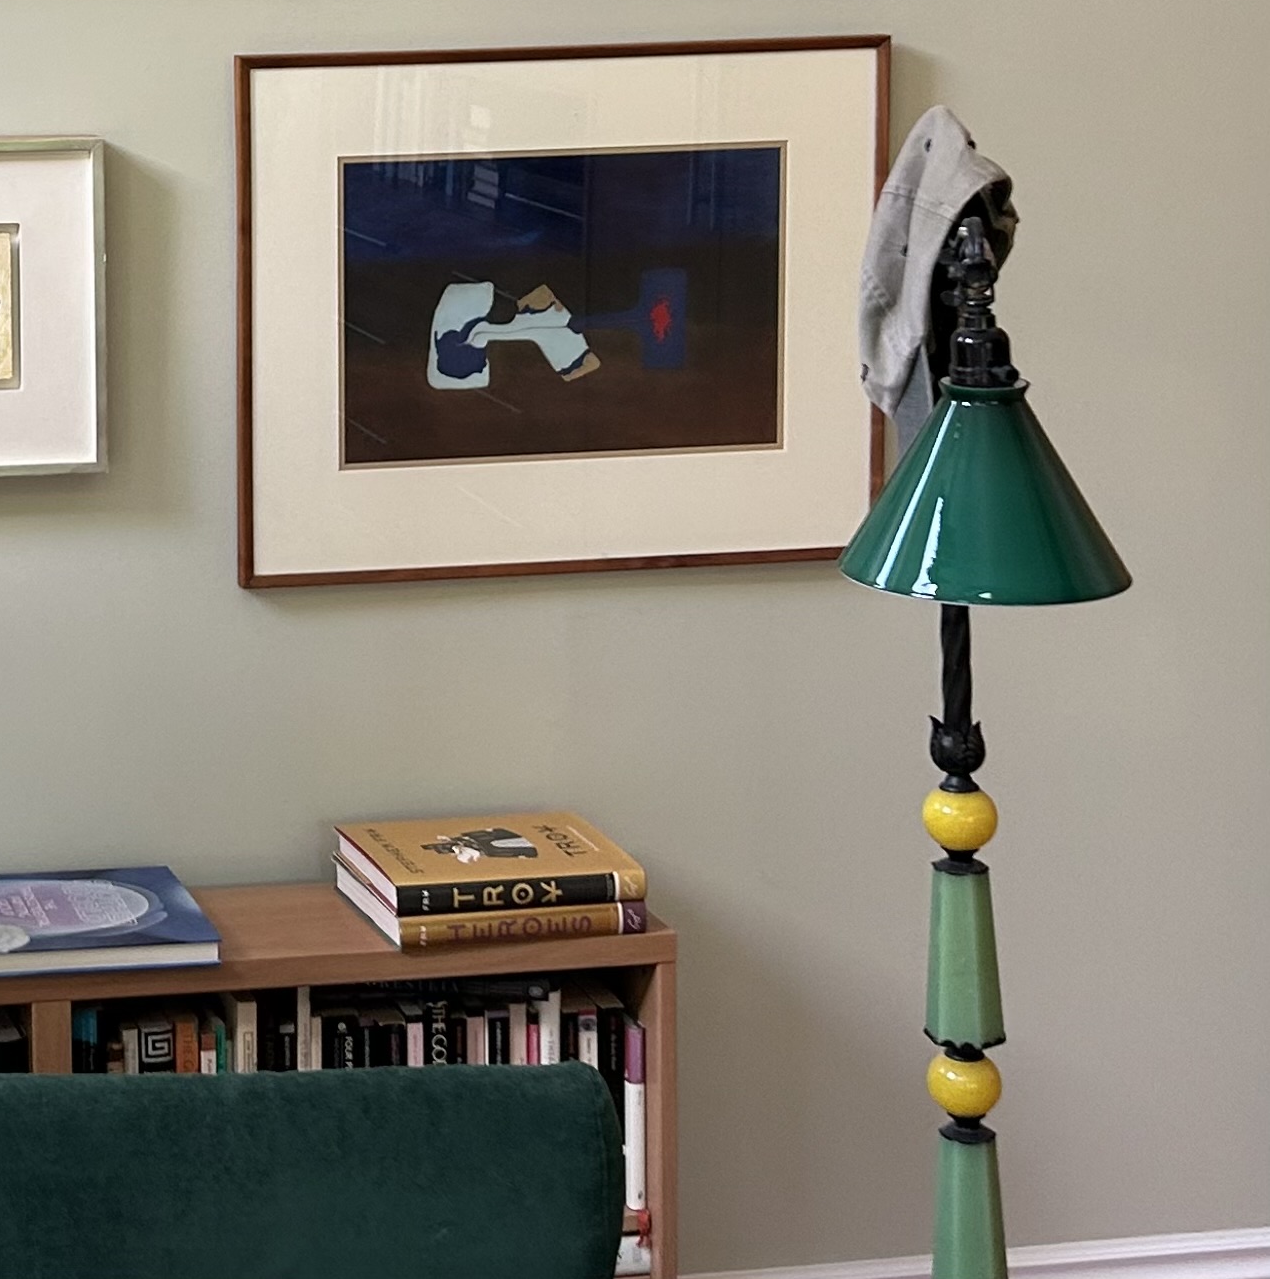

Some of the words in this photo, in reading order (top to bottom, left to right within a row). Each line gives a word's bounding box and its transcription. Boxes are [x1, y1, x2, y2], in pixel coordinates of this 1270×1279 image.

[531, 824, 588, 858] TROY
[451, 880, 564, 910] TROY
[445, 914, 593, 942] HEROES
[431, 1004, 447, 1034] THE
